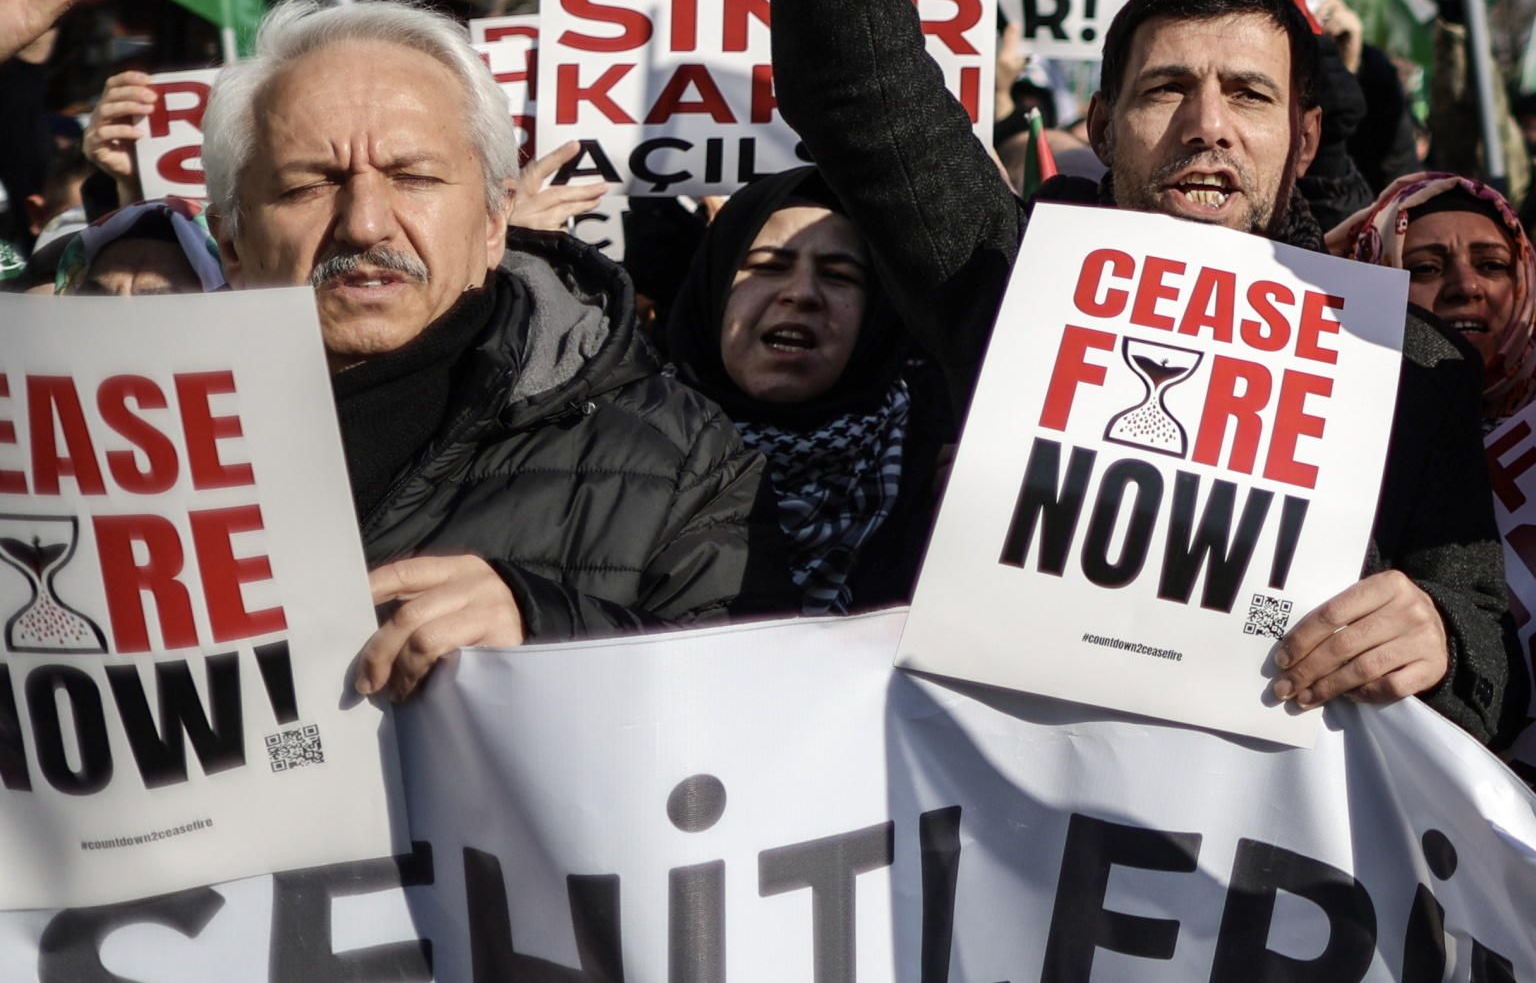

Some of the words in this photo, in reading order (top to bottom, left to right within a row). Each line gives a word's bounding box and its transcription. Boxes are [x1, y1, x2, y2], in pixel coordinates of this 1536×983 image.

[555, 63, 981, 124] KAI
[549, 137, 814, 193] AÇIL
[1073, 248, 1345, 365] CEASE
[998, 436, 1310, 614] NOW!
[1081, 632, 1183, 662] #countdown2ceasefire
[80, 817, 214, 851] #countdown2ceasefire
